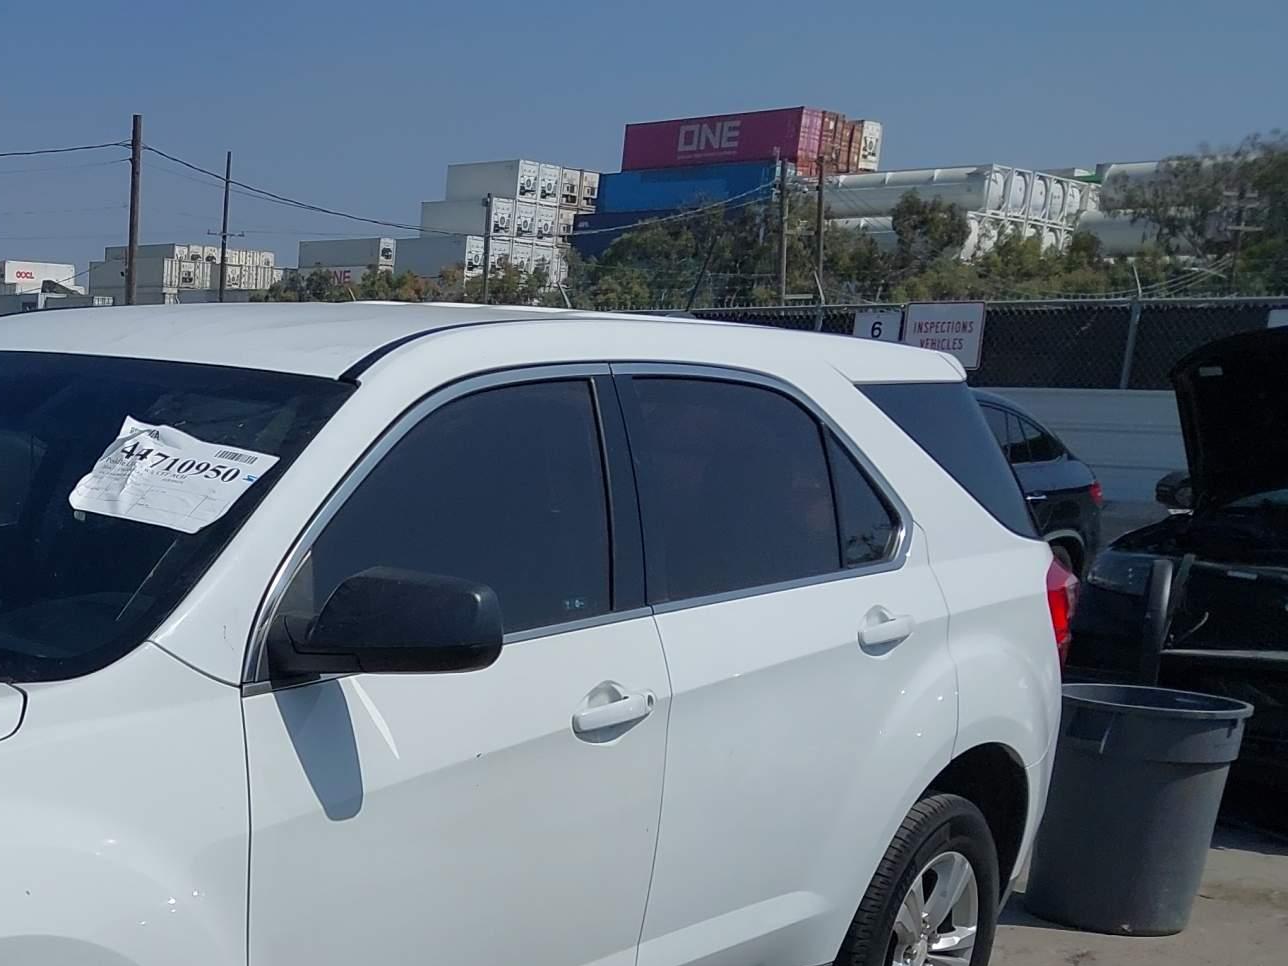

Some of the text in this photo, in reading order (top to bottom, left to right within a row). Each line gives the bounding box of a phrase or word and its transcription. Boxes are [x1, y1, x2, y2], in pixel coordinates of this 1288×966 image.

[677, 120, 741, 152] ONE
[15, 270, 35, 279] OOCL
[870, 321, 883, 339] 6
[913, 320, 975, 334] INSPECTIONS
[919, 338, 964, 351] VEHICLES
[120, 441, 241, 483] 44710950
